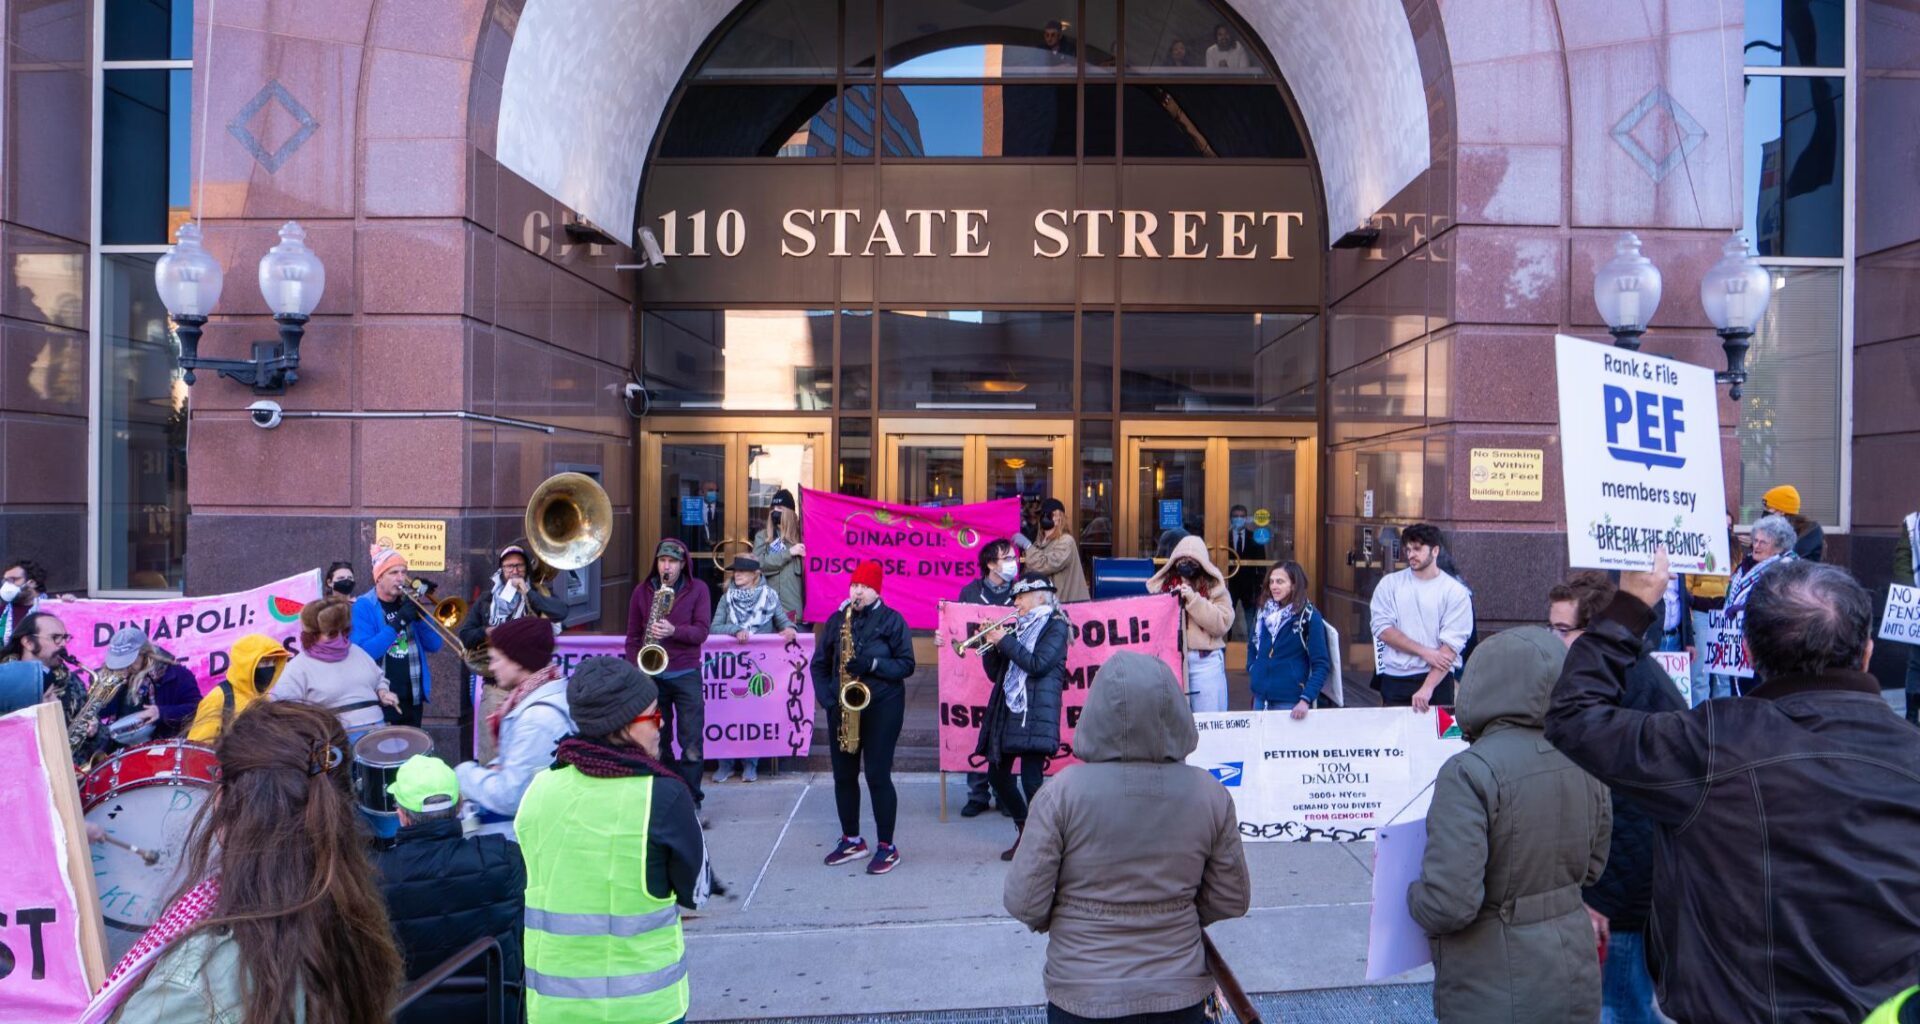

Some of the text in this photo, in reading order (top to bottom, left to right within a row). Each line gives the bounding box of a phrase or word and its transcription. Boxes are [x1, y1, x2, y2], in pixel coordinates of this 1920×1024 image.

[658, 208, 1303, 260] 110 STATE STREET
[1604, 353, 1678, 385] Rank & File
[1603, 383, 1685, 453] PEF
[1473, 450, 1540, 460] No Smoking
[1493, 461, 1534, 469] Within
[1490, 472, 1506, 480] 25
[1472, 488, 1540, 497] Building Entrance
[1602, 481, 1696, 513] members say
[397, 522, 443, 531] Smoking
[846, 530, 947, 548] DINAPOLI:
[1596, 523, 1706, 558] BREAK THE BONDS
[410, 559, 443, 567] Entrance
[918, 560, 979, 577] DIVES
[1891, 587, 1912, 604] NO
[1884, 622, 1904, 636] INTO
[704, 651, 751, 681] NDS
[1210, 720, 1225, 730] THE
[1226, 719, 1251, 730] BONDS
[705, 723, 779, 741] OCIDE!
[1263, 748, 1404, 760] PETITION DELIVERY TO:
[1318, 762, 1351, 773] TOM
[1339, 791, 1367, 799] NYers
[1293, 803, 1329, 811] DEMAND
[1304, 812, 1375, 821] FROM GENOCIDE
